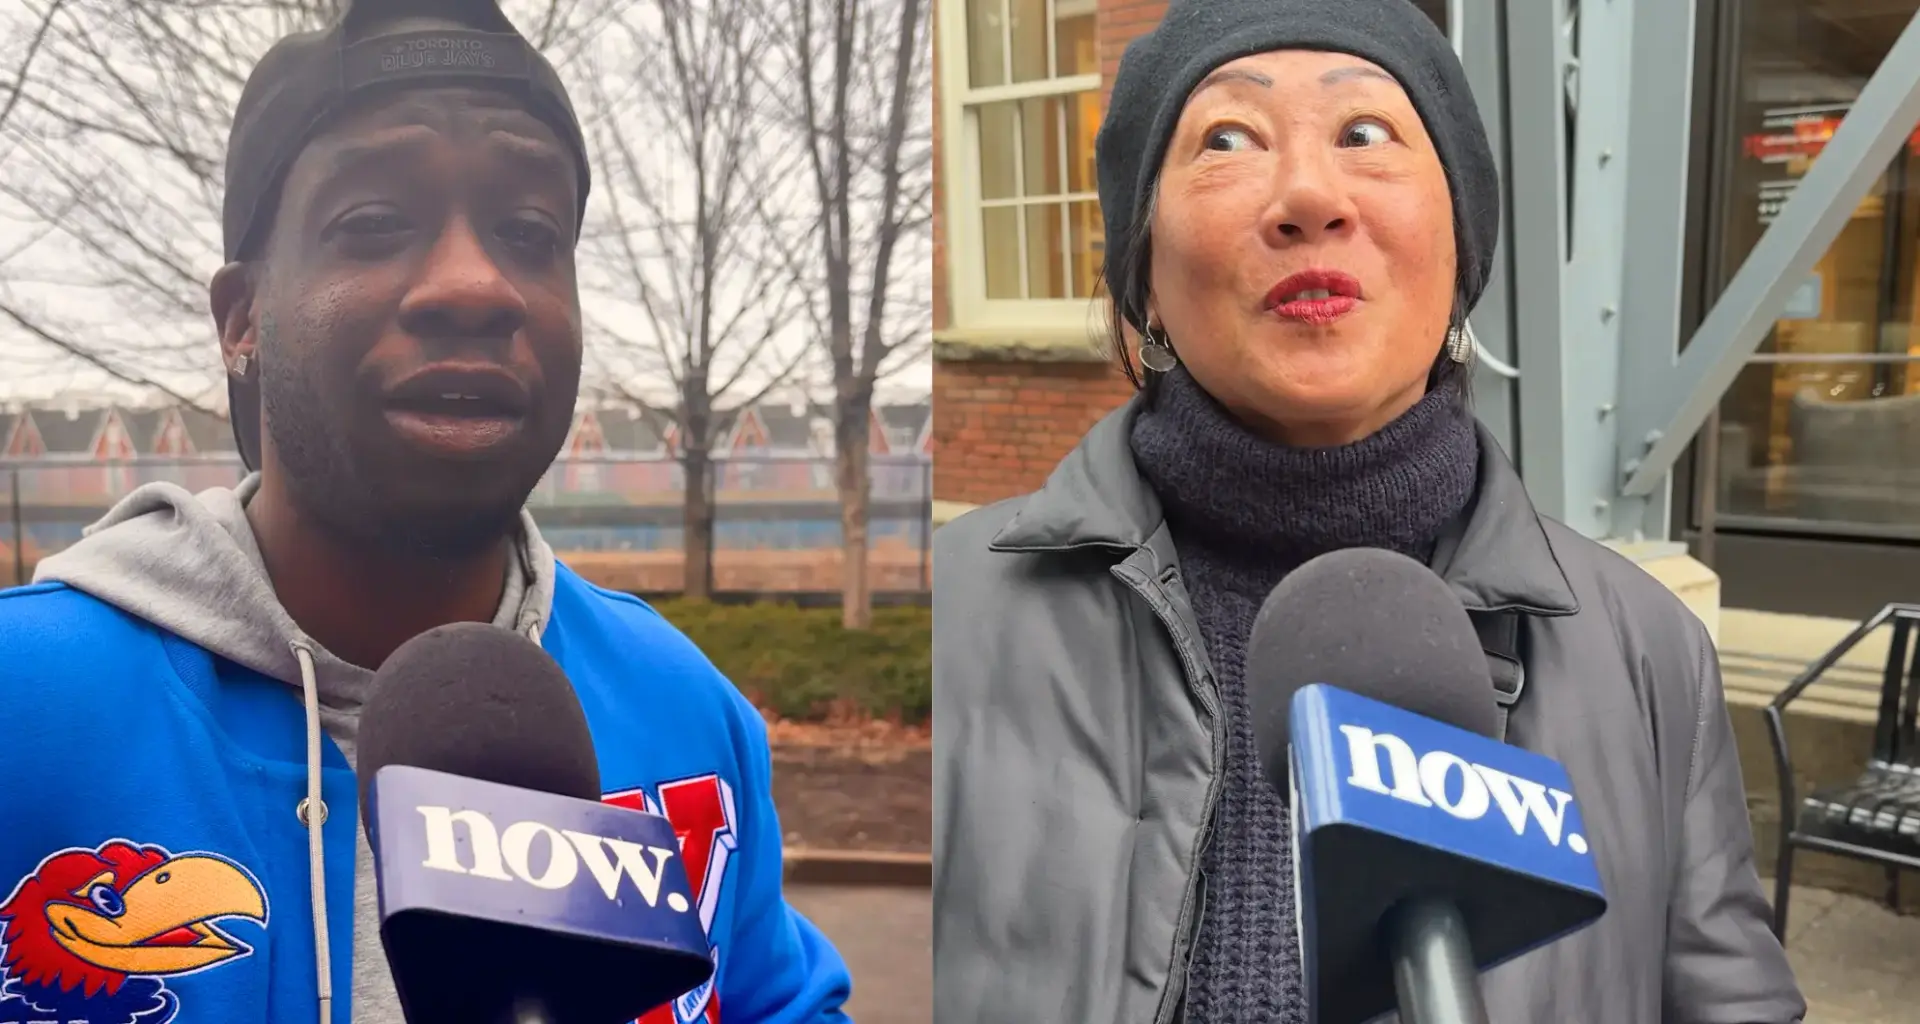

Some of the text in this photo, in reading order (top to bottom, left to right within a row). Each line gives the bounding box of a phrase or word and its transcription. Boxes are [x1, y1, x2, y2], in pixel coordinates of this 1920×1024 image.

[382, 50, 495, 72] BLUE JAYS
[405, 38, 483, 50] TORONTO
[1339, 724, 1588, 854] now.
[416, 805, 689, 913] now.
